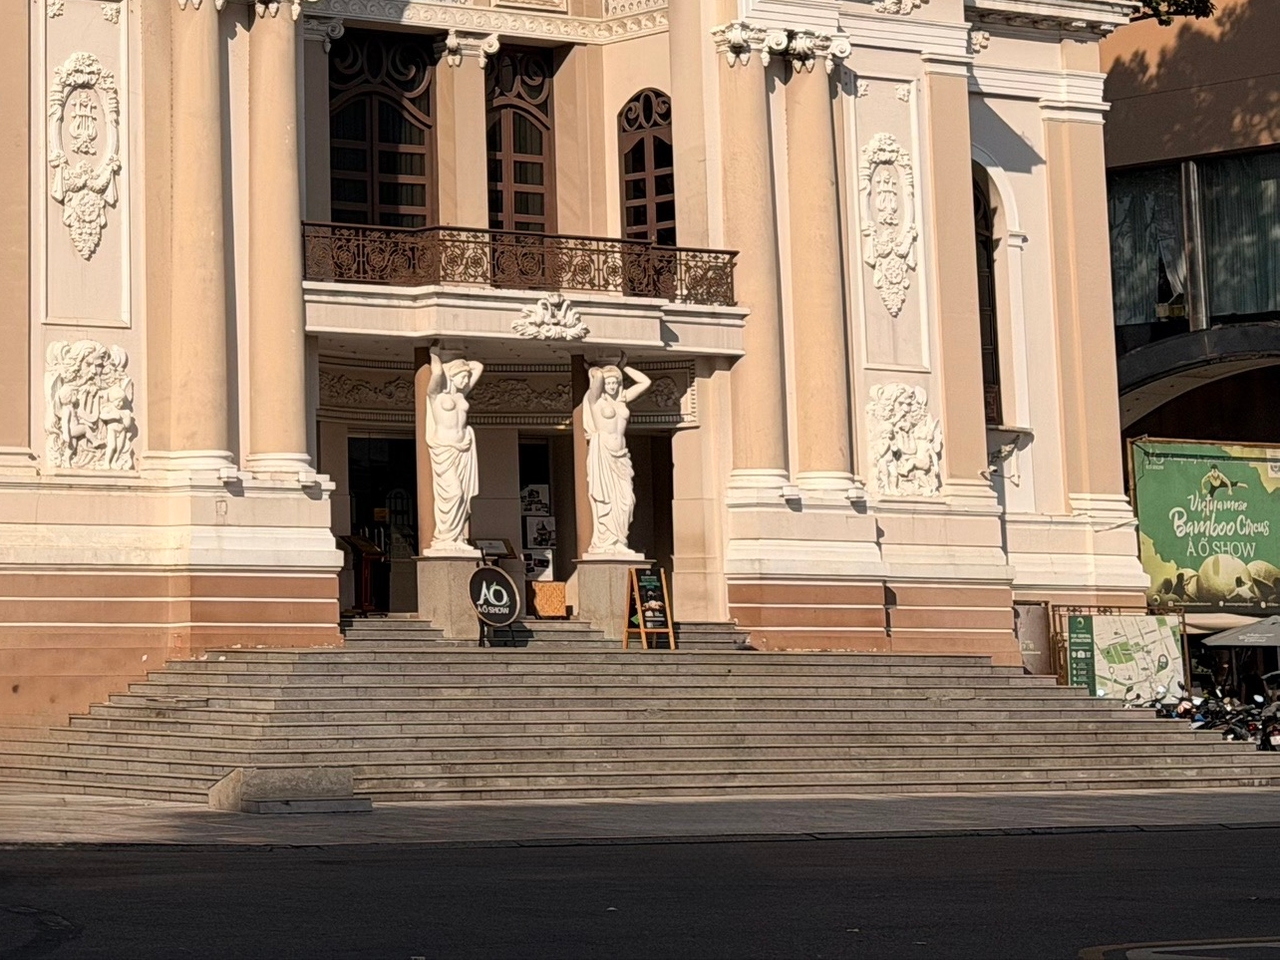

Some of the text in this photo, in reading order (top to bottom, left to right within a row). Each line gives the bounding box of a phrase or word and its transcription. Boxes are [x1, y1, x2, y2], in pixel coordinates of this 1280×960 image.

[1186, 490, 1248, 519] Vietnamese
[1168, 507, 1270, 538] Bamboo Circus
[1186, 537, 1197, 557] À
[1211, 541, 1256, 558] SHOW
[488, 606, 510, 614] SHOW
